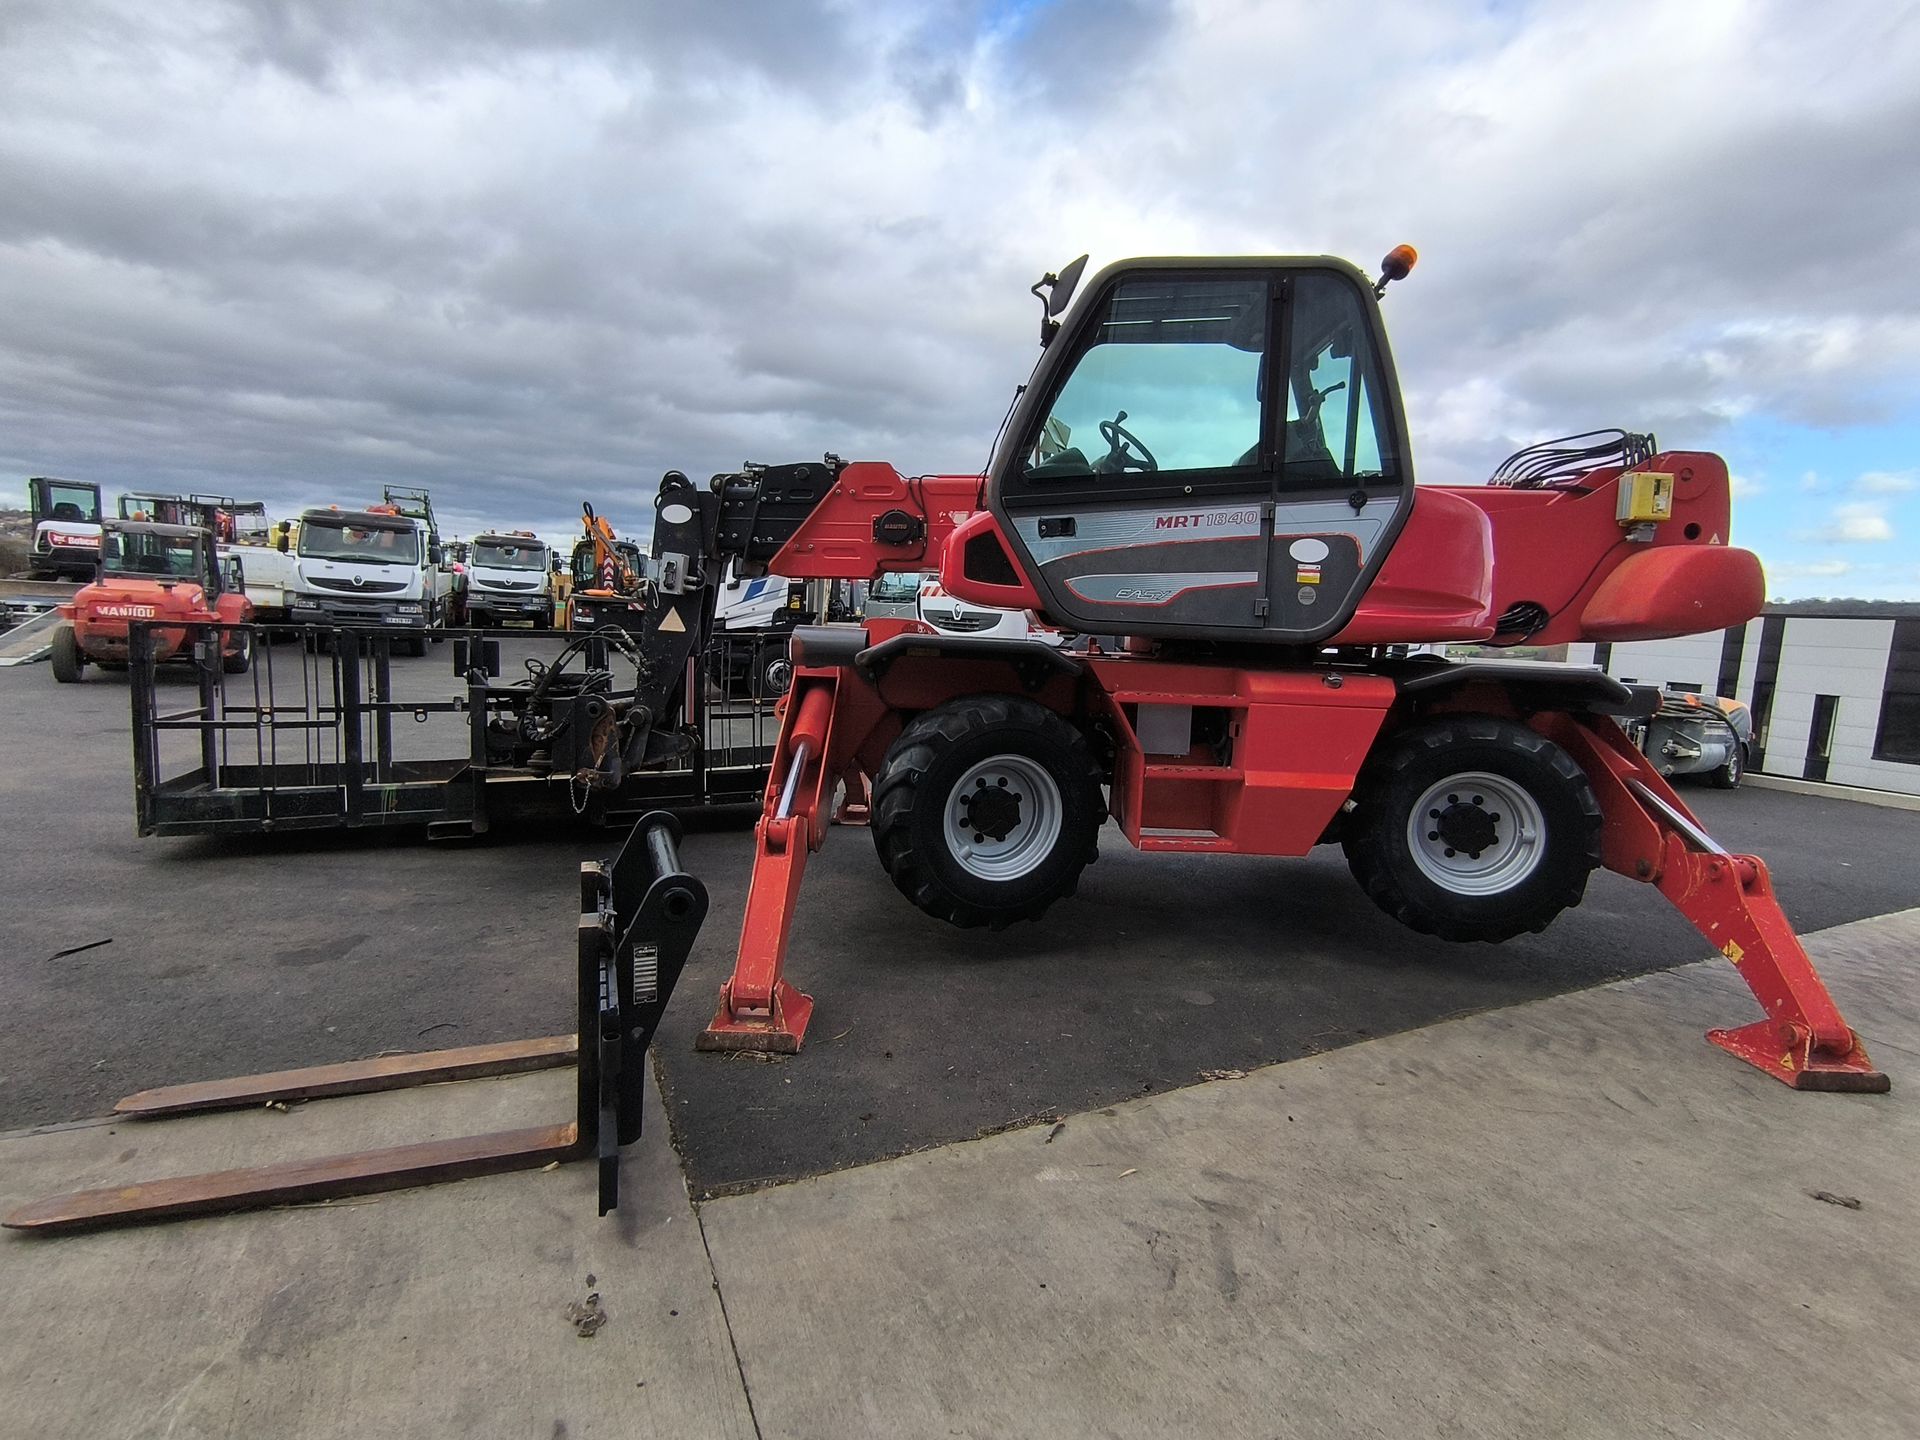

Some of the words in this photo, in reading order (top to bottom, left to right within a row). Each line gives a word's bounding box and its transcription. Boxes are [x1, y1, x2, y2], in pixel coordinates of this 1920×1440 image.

[1155, 514, 1205, 529] MRT
[1206, 510, 1258, 527] 1840
[1115, 587, 1171, 601] EASY
[96, 604, 155, 618] MANITOU
